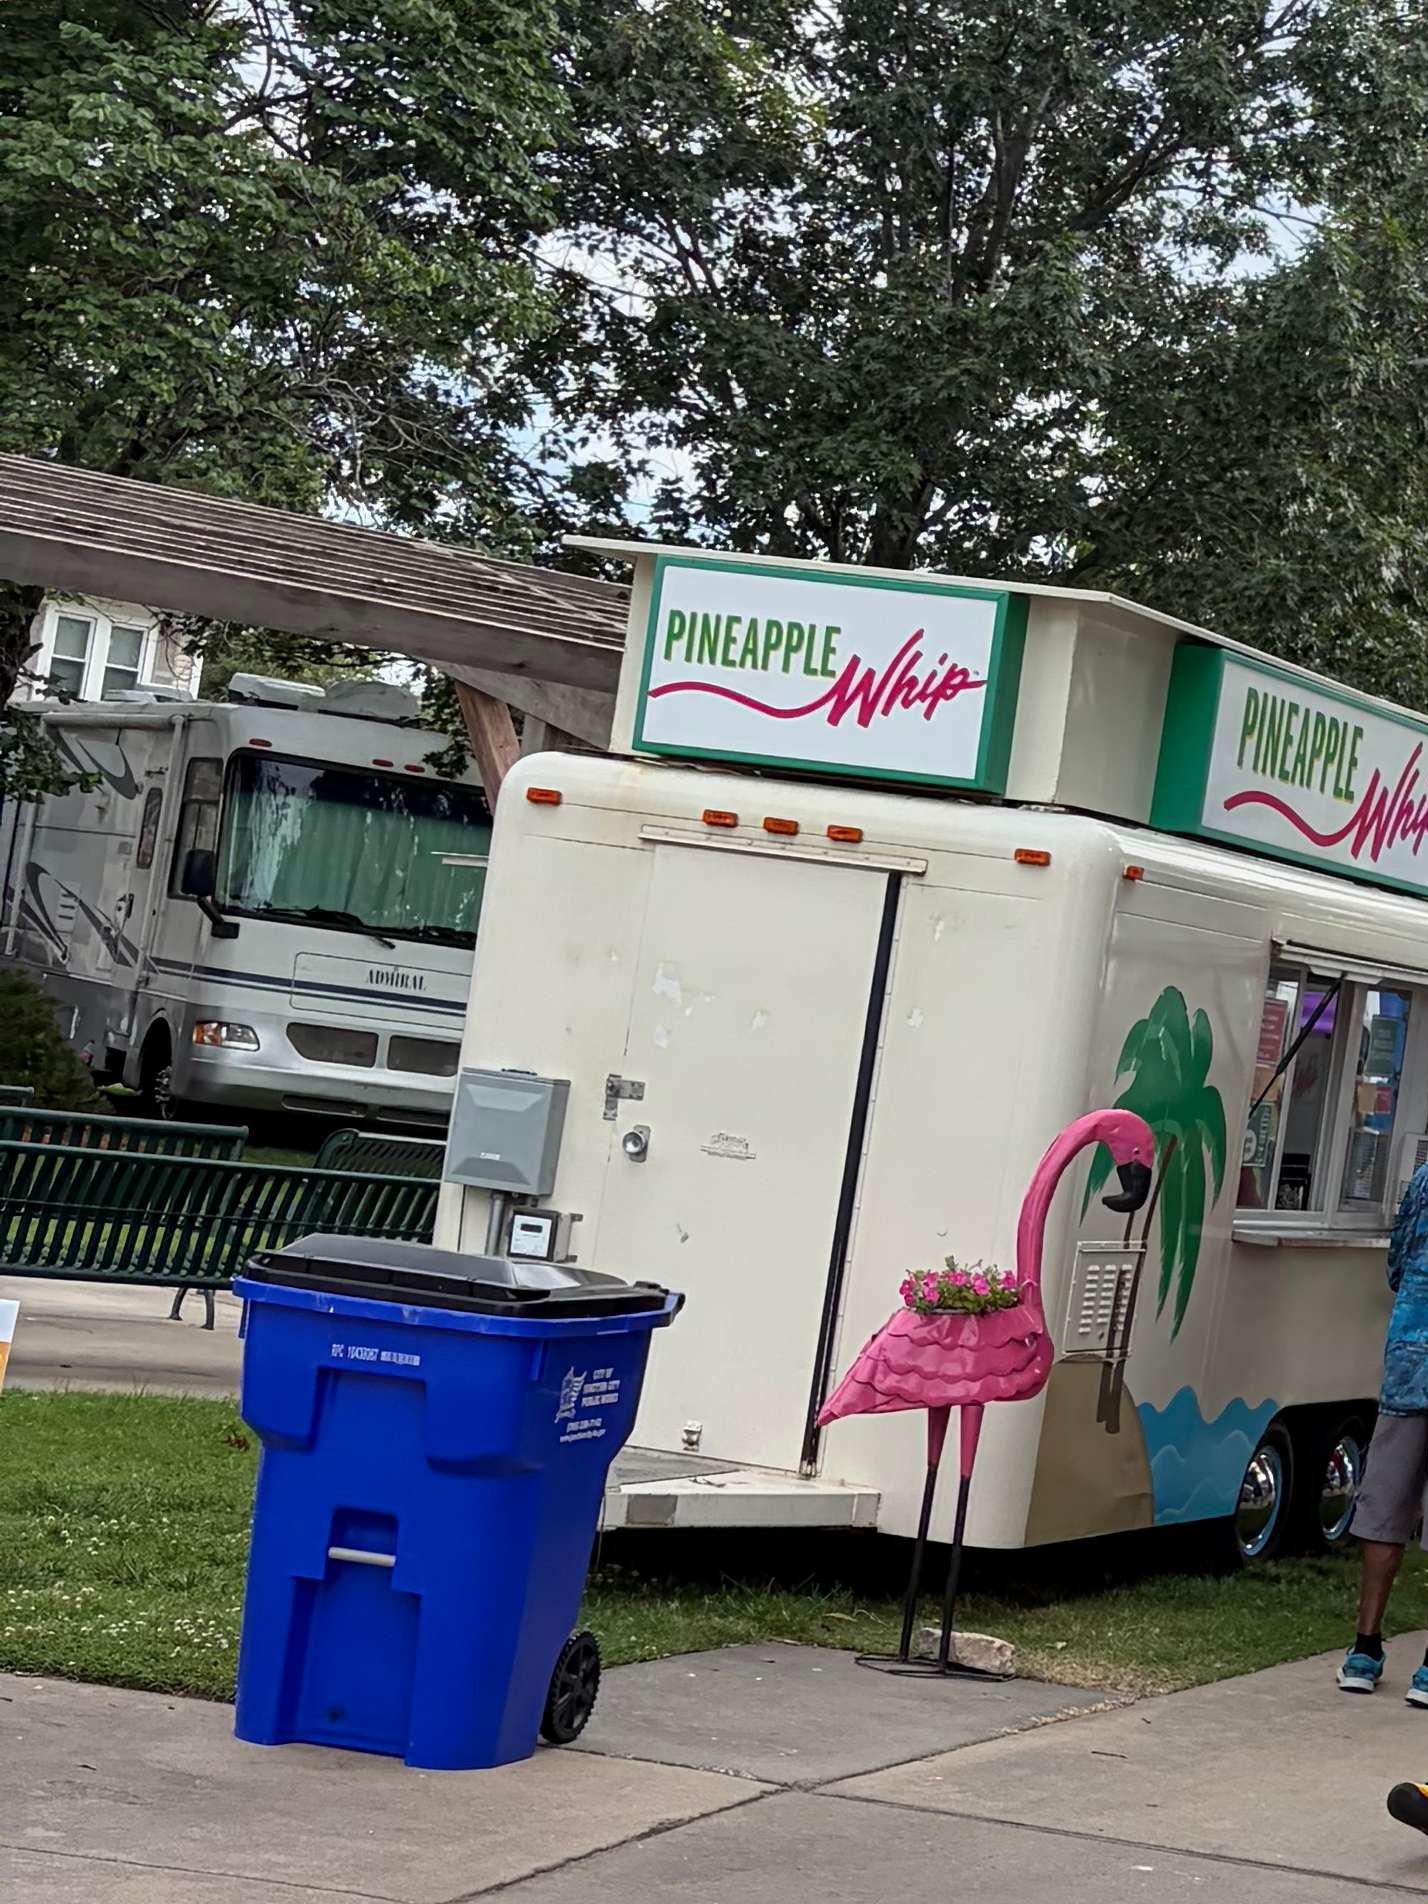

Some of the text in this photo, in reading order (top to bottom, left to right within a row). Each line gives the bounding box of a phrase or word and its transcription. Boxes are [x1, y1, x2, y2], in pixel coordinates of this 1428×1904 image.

[664, 608, 842, 679] PINEAPPLE
[824, 627, 987, 729] Whip
[1236, 686, 1364, 805] PINEAPPLE
[368, 968, 427, 991] ADMIRAL
